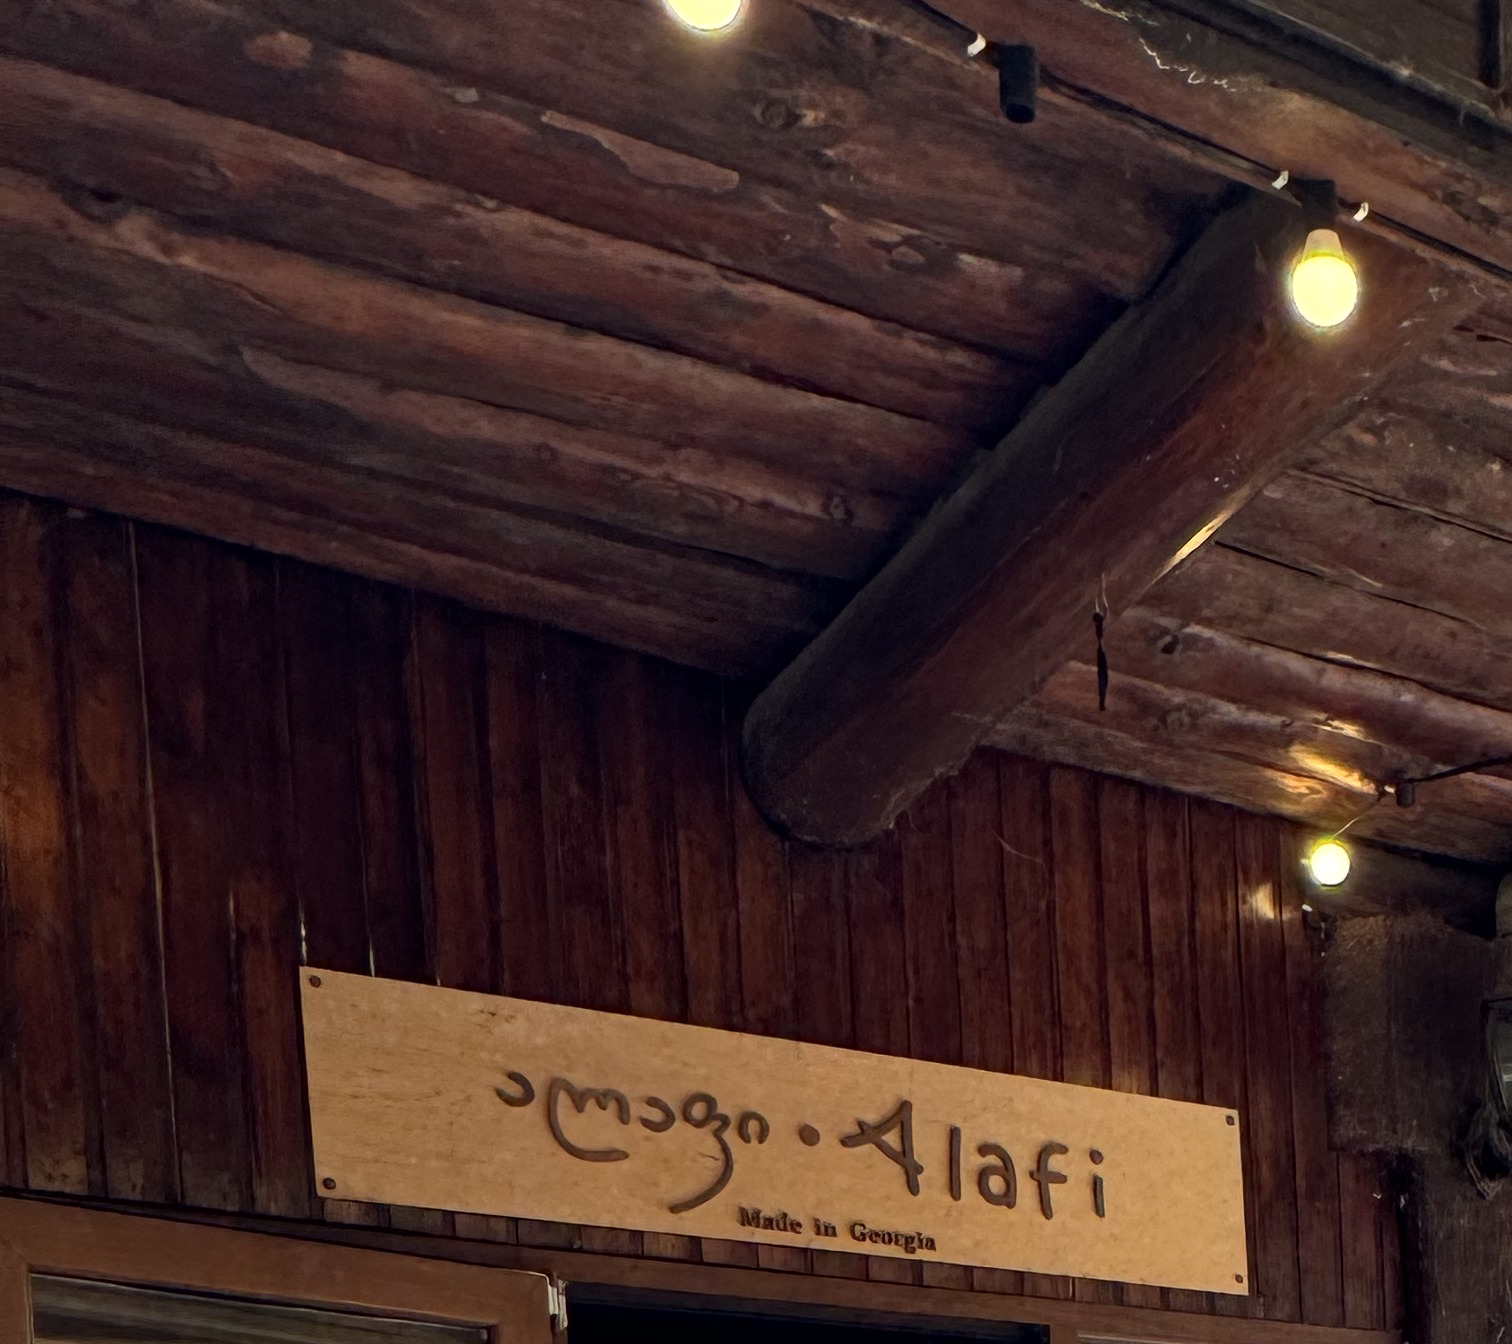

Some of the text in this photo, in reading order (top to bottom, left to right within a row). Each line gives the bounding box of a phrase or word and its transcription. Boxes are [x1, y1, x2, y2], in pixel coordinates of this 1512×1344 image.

[841, 1099, 1107, 1220] Alafi
[738, 1206, 937, 1255] Made in Georgia
